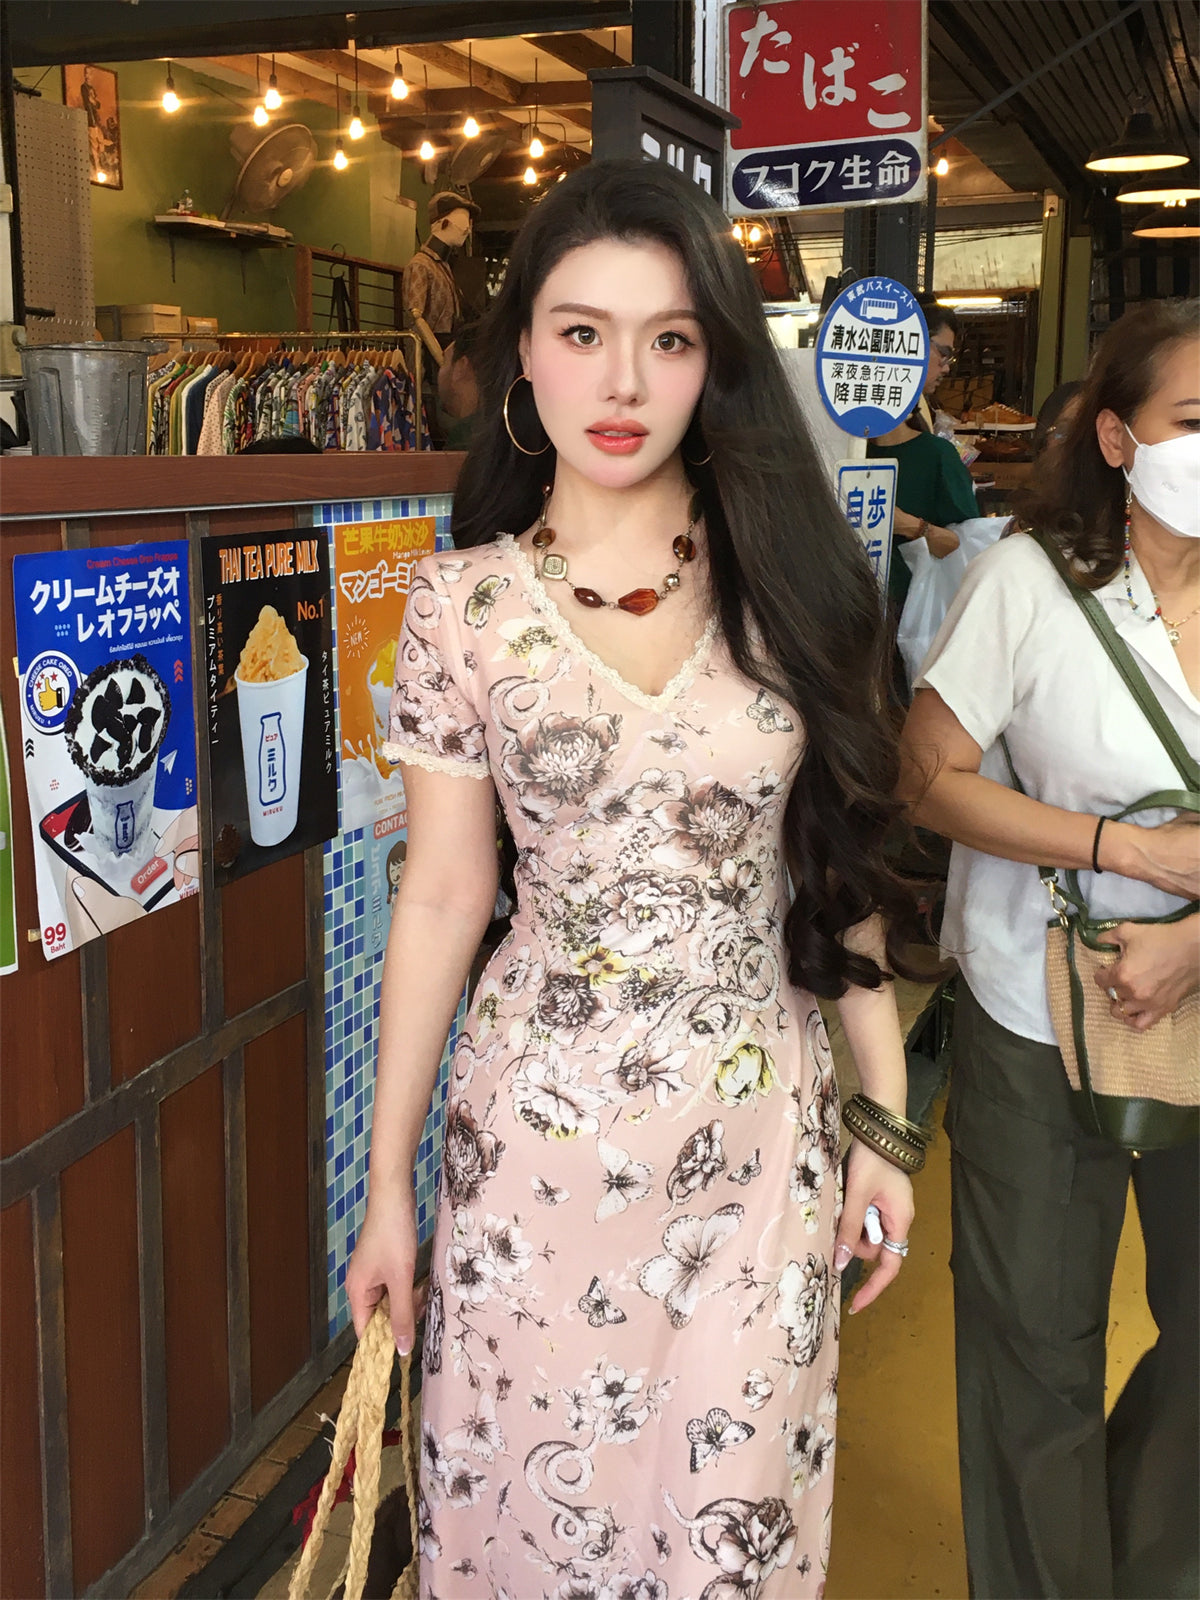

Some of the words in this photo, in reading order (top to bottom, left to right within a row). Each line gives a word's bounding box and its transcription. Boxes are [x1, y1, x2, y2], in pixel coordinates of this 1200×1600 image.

[739, 11, 911, 129] たばこ
[741, 150, 912, 198] フコク生命
[831, 324, 920, 356] 清水公園駅入口
[831, 362, 912, 384] 深夜急行バス
[833, 382, 903, 408] 降車専用
[342, 520, 429, 556] 芒果牛奶冰沙
[86, 559, 112, 570] Cream
[219, 547, 242, 584] THAI
[243, 545, 264, 581] TEA
[264, 541, 294, 578] PURE
[295, 540, 320, 574] MILK
[30, 566, 180, 615] クリームチーズオ
[77, 598, 182, 643] レオフラッペ
[297, 598, 324, 621] No.1
[28, 663, 43, 688] CHEESE
[42, 658, 58, 667] CAKE
[58, 661, 73, 677] OREO
[267, 748, 277, 792] ミルク
[262, 805, 283, 816] MIRUKU
[137, 860, 160, 884] Order
[44, 922, 66, 946] 99
[50, 943, 66, 953] Baht
